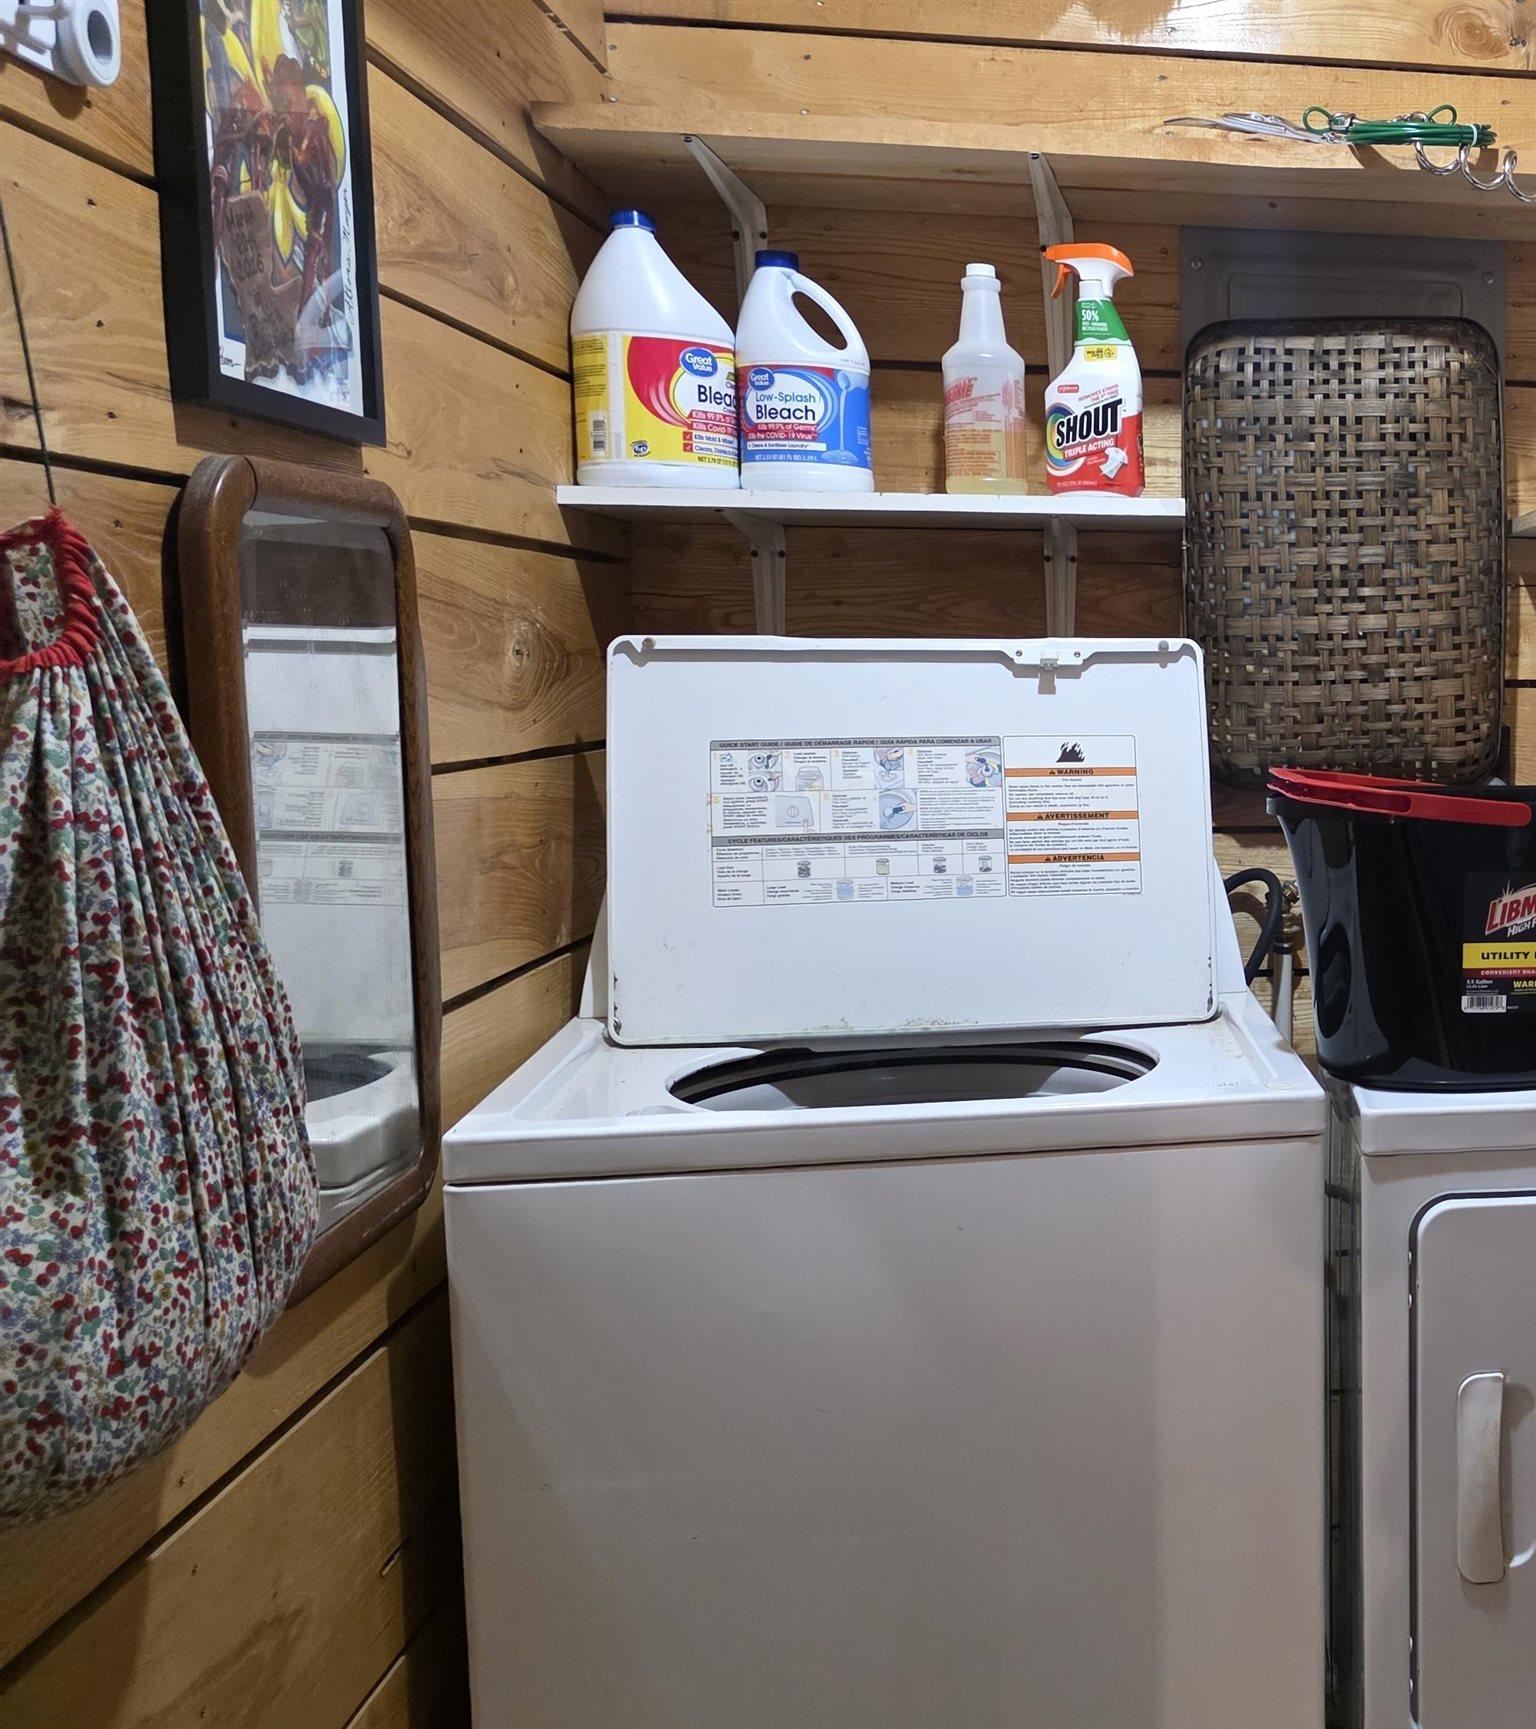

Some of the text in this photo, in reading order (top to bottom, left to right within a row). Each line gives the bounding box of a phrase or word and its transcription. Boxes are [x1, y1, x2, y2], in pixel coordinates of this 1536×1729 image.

[1082, 309, 1099, 322] 50%
[685, 353, 712, 368] Great
[692, 361, 713, 373] Value
[750, 373, 769, 382] Great
[698, 384, 737, 409] Bleac
[755, 392, 816, 404] Low-Splash
[755, 404, 816, 421] Bleach
[1056, 398, 1123, 448] SHOUT
[1065, 438, 1115, 458] TRIPLE ACTING
[1507, 922, 1531, 938] HIGH
[1481, 951, 1531, 960] UTILITY
